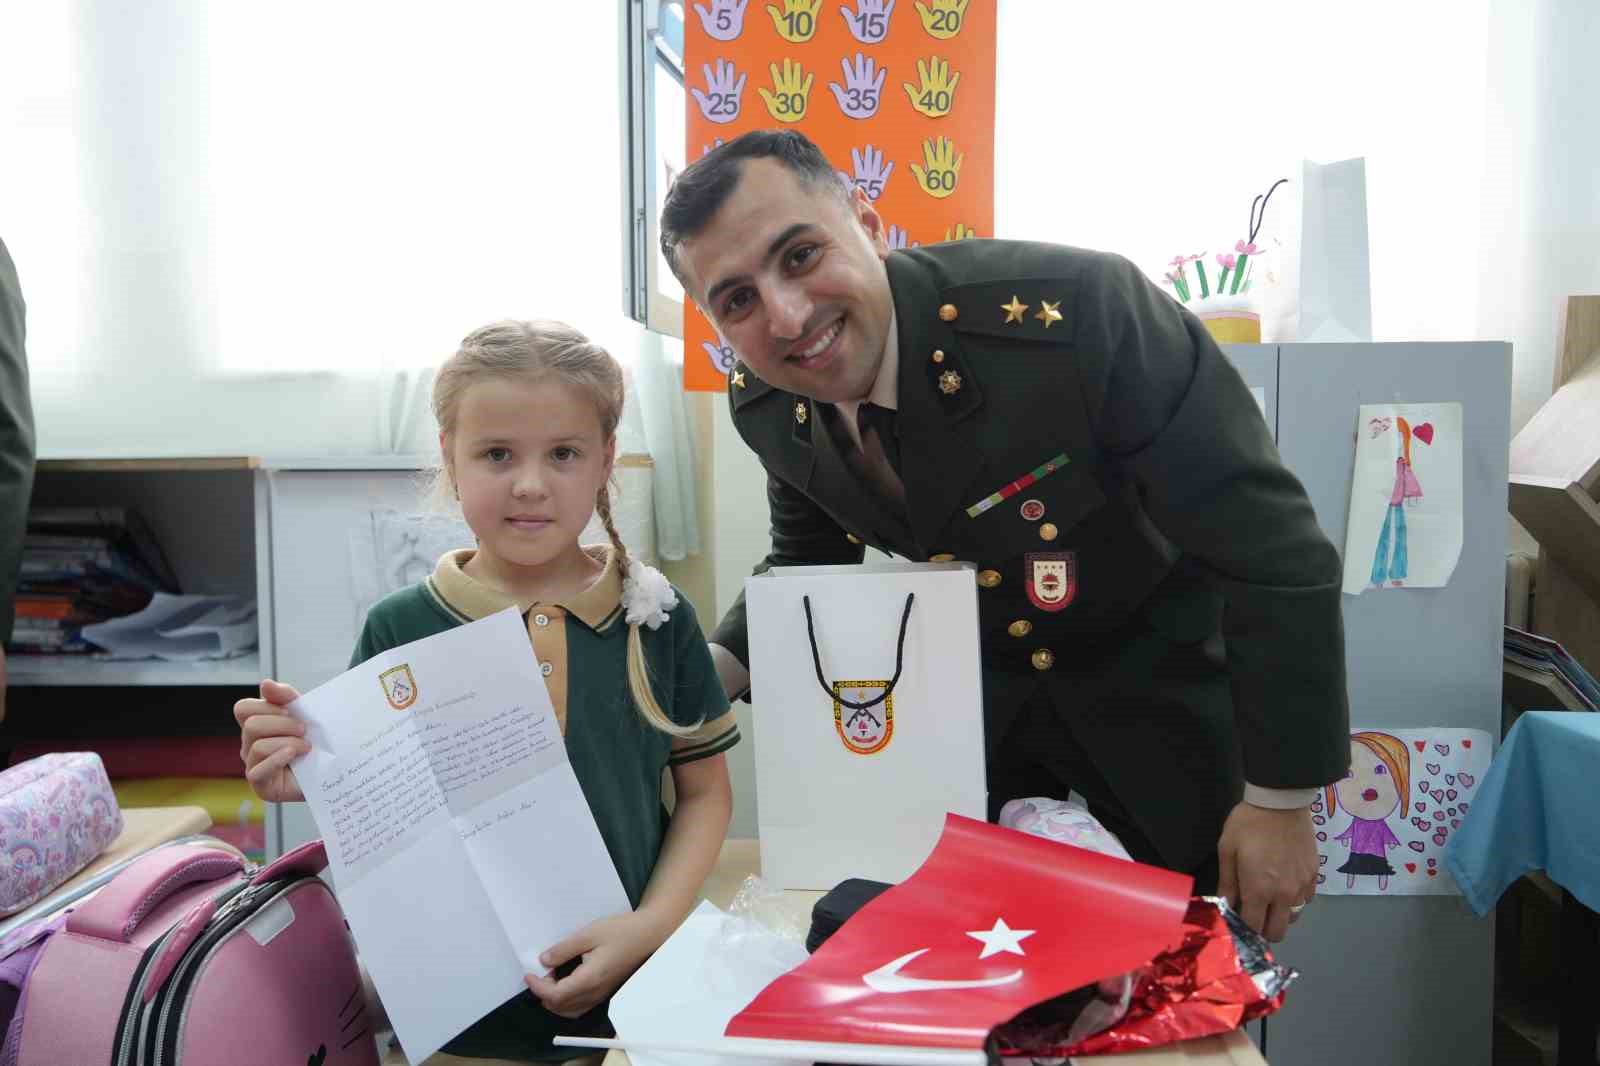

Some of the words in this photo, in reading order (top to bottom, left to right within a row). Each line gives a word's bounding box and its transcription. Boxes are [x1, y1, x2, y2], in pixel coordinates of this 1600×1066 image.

[716, 9, 732, 31] 5
[782, 11, 813, 37] 10
[854, 13, 885, 38] 15
[930, 9, 960, 32] 20
[707, 93, 738, 115] 25
[775, 93, 805, 115] 30
[846, 88, 877, 111] 35
[918, 91, 950, 112] 40
[926, 169, 956, 191] 60
[720, 346, 736, 369] 8
